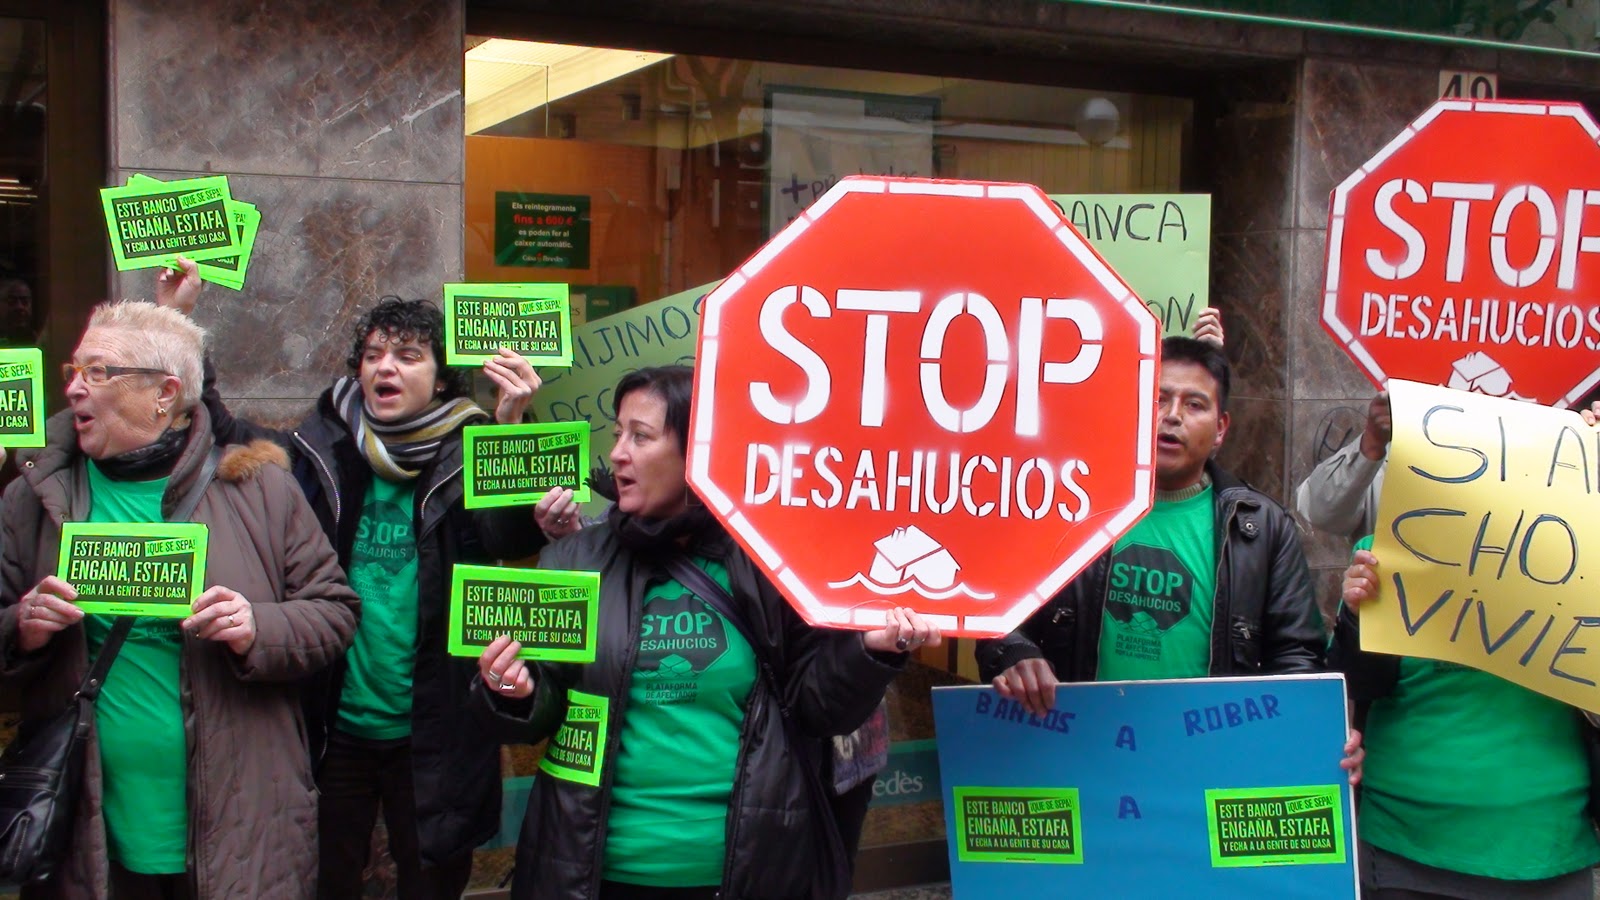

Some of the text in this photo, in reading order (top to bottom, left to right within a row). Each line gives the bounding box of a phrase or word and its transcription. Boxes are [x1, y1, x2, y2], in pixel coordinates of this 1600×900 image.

[198, 193, 206, 202] SE
[117, 198, 176, 218] ESTE BANCO
[120, 215, 176, 240] ENGAÑA,
[176, 210, 224, 234] ESTAFA
[1051, 200, 1187, 242] ANCA
[125, 231, 226, 252] Y ECHA A LA GENTE DE SU CASA
[1365, 178, 1600, 290] STOP
[458, 301, 516, 316] ESTE BANCO
[536, 302, 542, 310] SE
[458, 318, 558, 339] ENGAÑA, ESTAFA
[1360, 292, 1600, 350] DESAHUCIOS
[458, 340, 558, 351] Y ECHA A LA GENTE DE SU CASA
[749, 284, 1103, 437] STOP
[11, 364, 33, 377] SEPA!
[0, 390, 28, 411] AFA
[6, 416, 28, 428] CASA
[476, 440, 534, 455] ESTE BANCO
[556, 437, 562, 446] SE
[476, 454, 576, 477] ENGAÑA, ESTAFA
[477, 476, 576, 490] Y ECHA A LA GENTE DE SU CASA
[744, 443, 1091, 522] DESAHUCIOS
[74, 540, 140, 558] ESTE BANCO
[165, 542, 174, 552] SE
[70, 559, 188, 584] ENGAÑA, ESTAFA
[1111, 562, 1183, 596] STOP
[78, 584, 96, 596] ECHA
[98, 585, 104, 596] A
[106, 585, 114, 596] LA
[116, 586, 140, 596] GENTE
[142, 586, 152, 597] DE
[154, 586, 164, 598] SU
[166, 587, 186, 598] CASA
[468, 586, 534, 604] ESTE BANCO
[560, 589, 568, 598] SE
[1108, 590, 1181, 612] DESAHUCIOS
[466, 604, 582, 629] ENGAÑA, ESTAFA
[641, 612, 712, 636] STOP
[466, 630, 472, 639] Y
[474, 630, 492, 640] ECHA
[514, 630, 536, 642] GENTE
[538, 632, 548, 642] DE
[550, 632, 560, 642] SU
[562, 632, 582, 644] CASA
[640, 638, 717, 650] ESAHUCIOS
[1115, 726, 1136, 752] A
[1184, 694, 1282, 736] ROBAR
[575, 754, 591, 766] CASA
[872, 770, 923, 796] edès
[966, 801, 1025, 815] ESTE BANCO
[1046, 800, 1054, 810] SE
[1117, 795, 1142, 820] A
[1220, 802, 1282, 818] ESTE BANCO
[1304, 800, 1313, 808] SE
[968, 816, 1069, 837] ENGAÑA, ESTAFA
[1221, 818, 1330, 838] ENGAÑA, ESTAFA
[970, 838, 1070, 849] Y ECHA A LA GENTE DE SU CASA
[1223, 838, 1332, 852] Y ECHA A LA GENTE DE SU CASA
